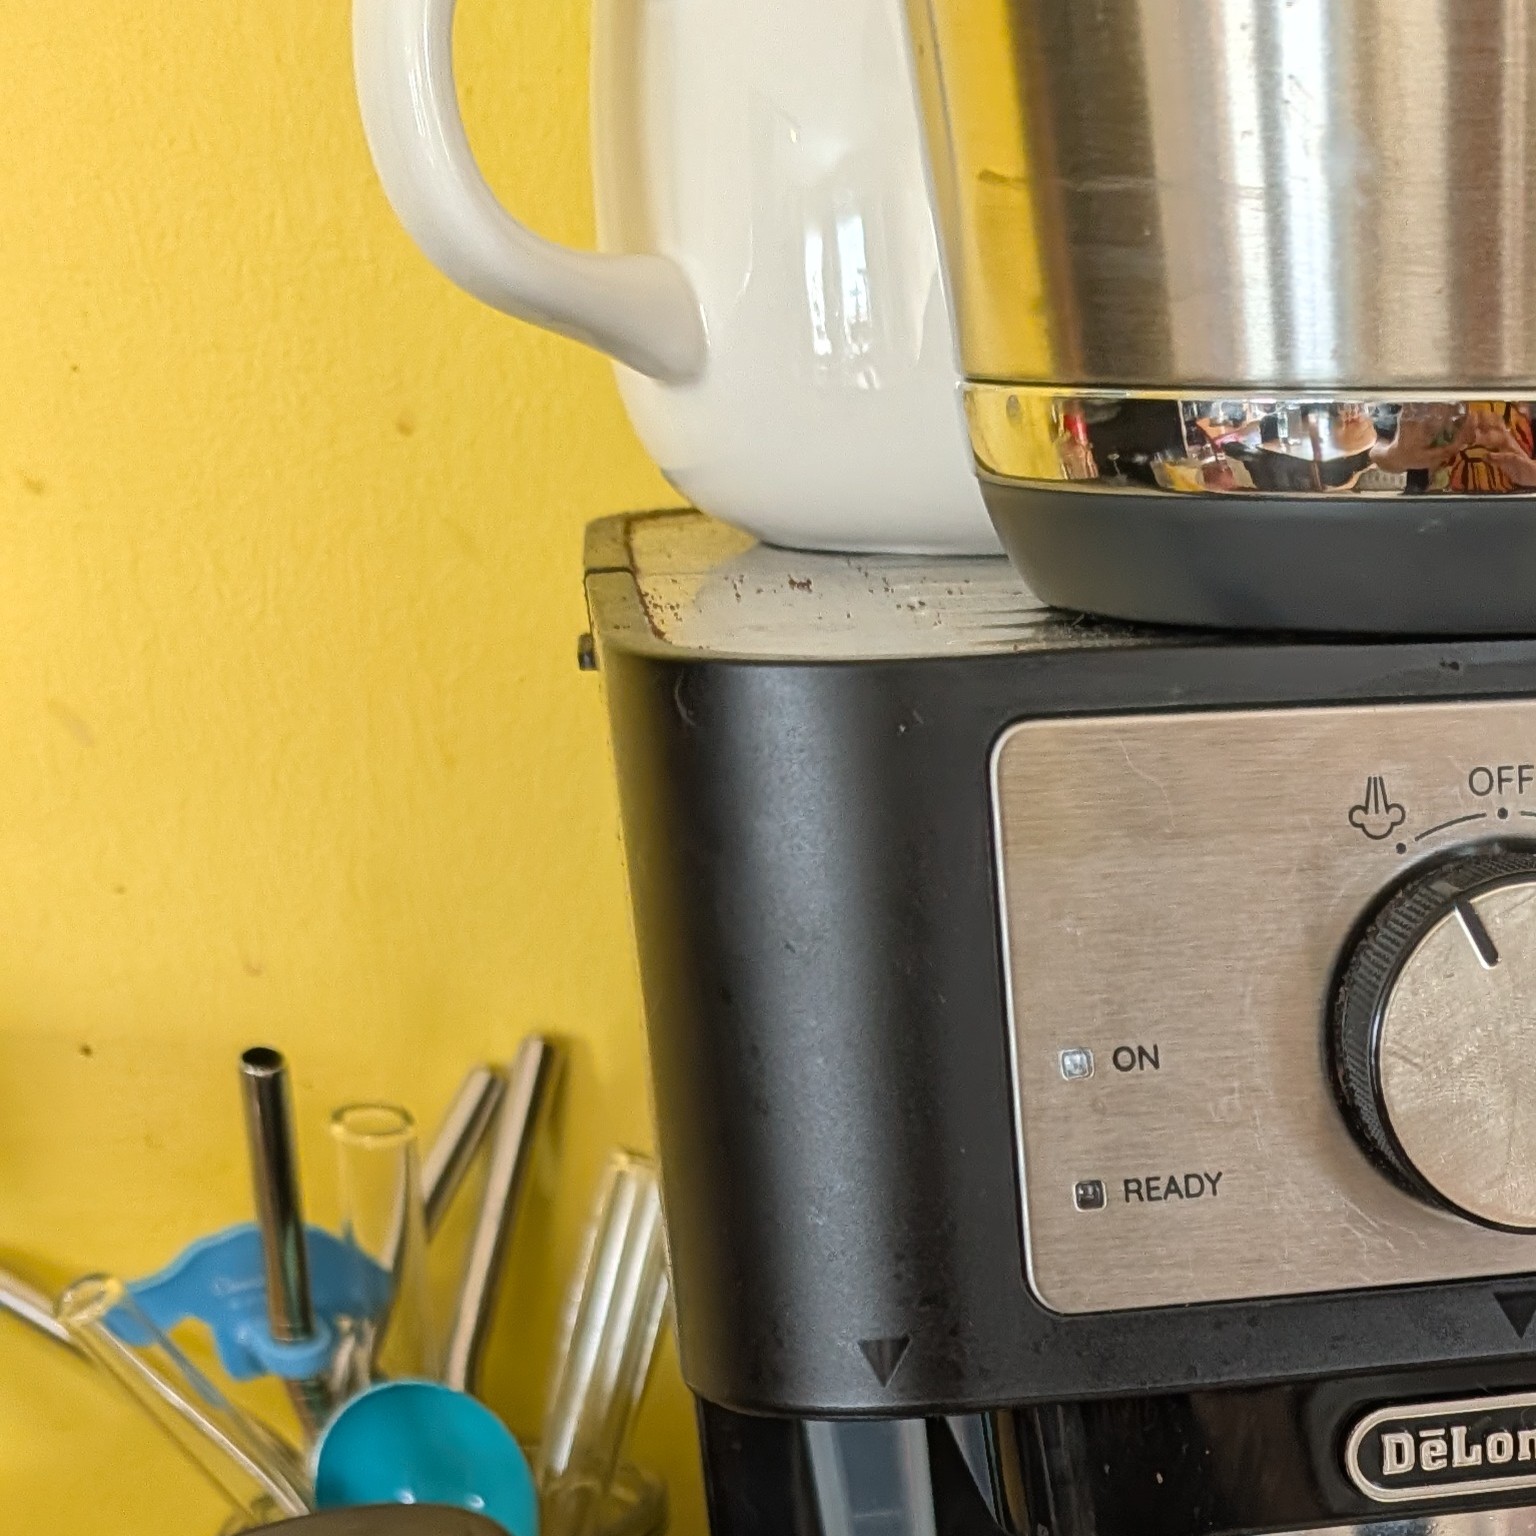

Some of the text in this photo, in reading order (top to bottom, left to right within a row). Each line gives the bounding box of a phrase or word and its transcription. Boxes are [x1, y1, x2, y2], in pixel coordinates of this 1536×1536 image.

[1468, 764, 1535, 797] OFF
[1112, 1043, 1161, 1073] ON
[1123, 1171, 1223, 1204] READY
